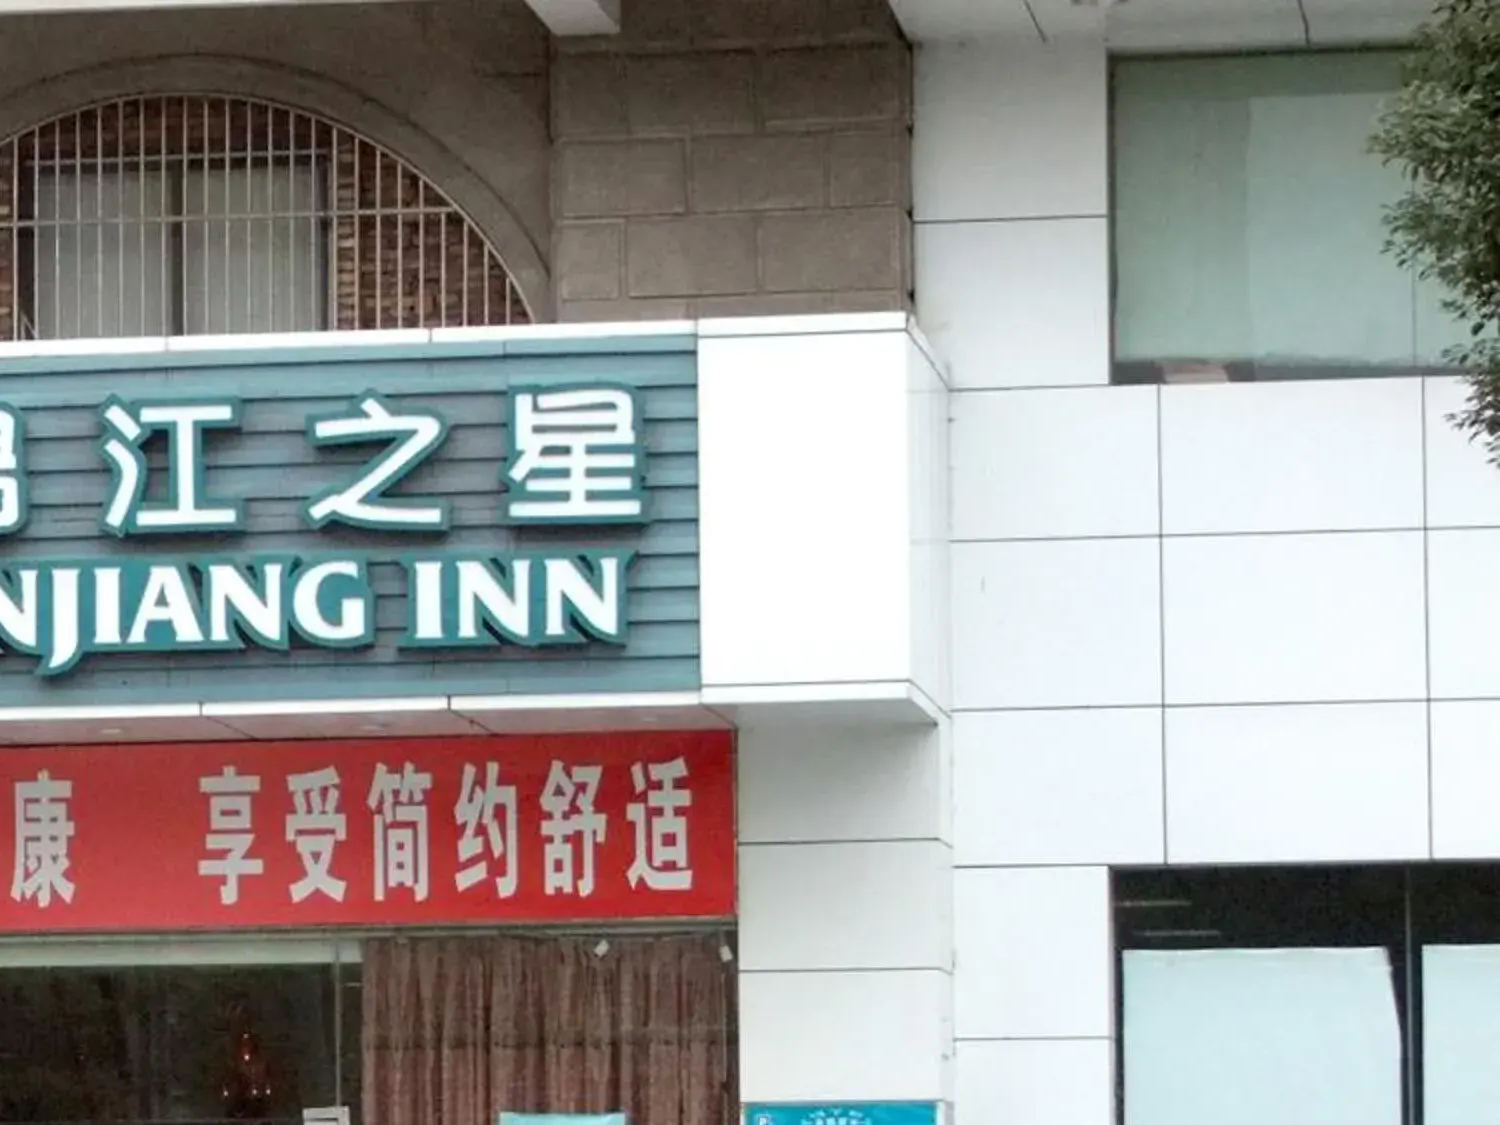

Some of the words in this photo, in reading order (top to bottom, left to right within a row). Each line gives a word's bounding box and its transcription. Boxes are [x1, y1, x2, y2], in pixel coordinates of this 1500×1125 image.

[413, 555, 628, 643] INN
[197, 759, 694, 905] 享受简约舒适
